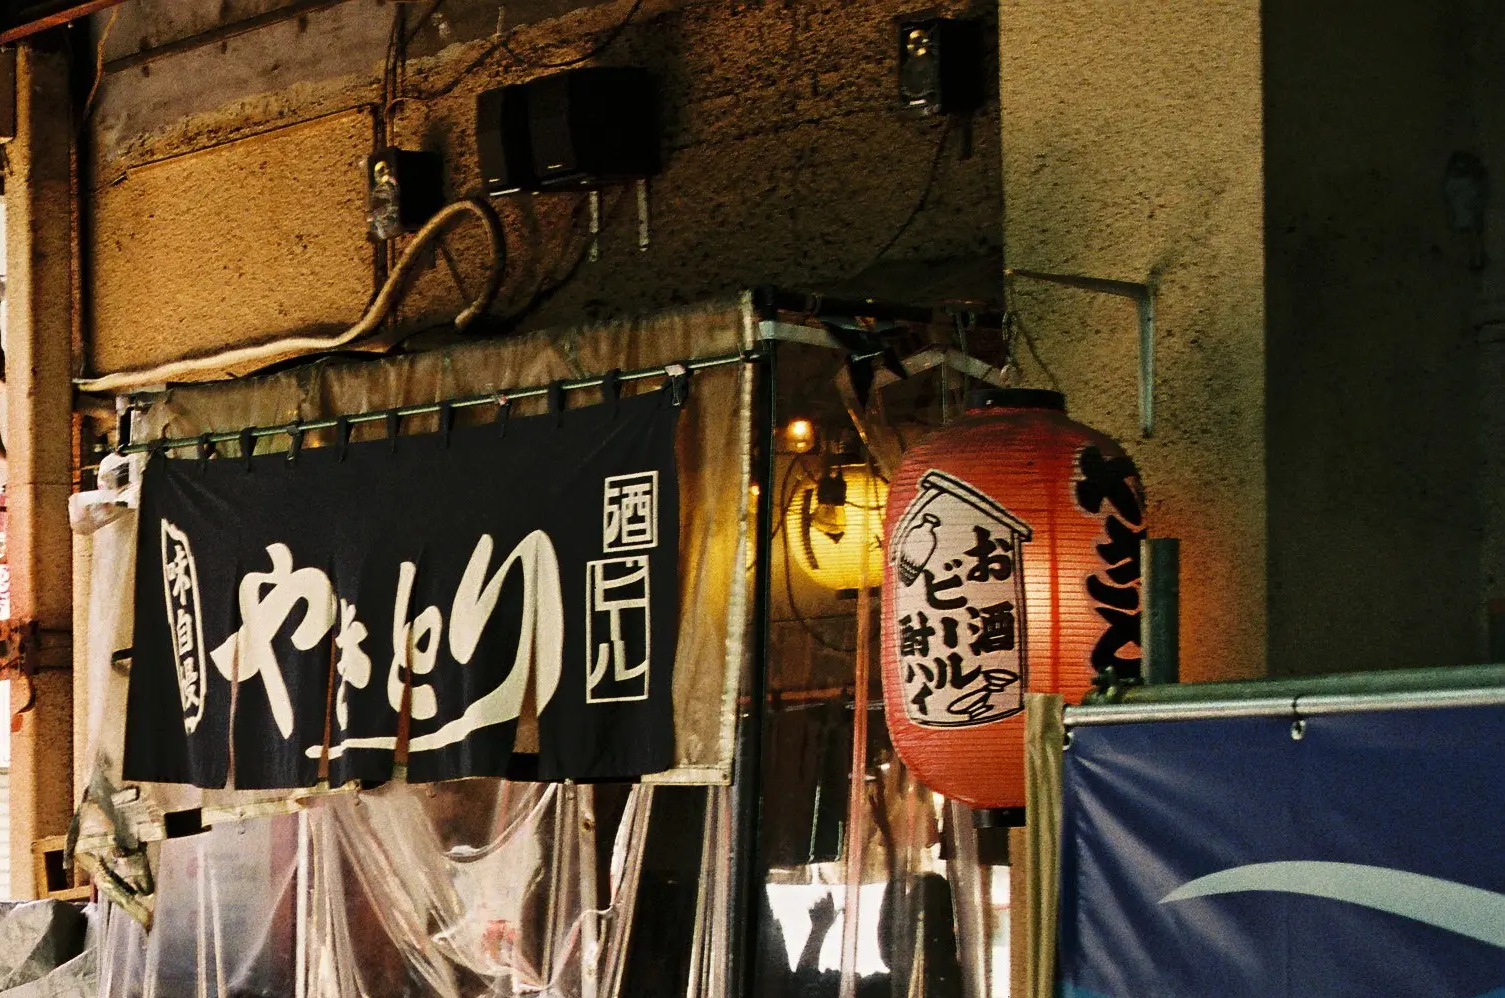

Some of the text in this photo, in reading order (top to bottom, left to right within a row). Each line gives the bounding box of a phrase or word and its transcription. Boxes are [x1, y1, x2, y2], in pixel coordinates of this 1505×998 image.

[604, 480, 654, 549] 酒
[210, 529, 564, 759] やきとり
[924, 558, 982, 690] ビール
[965, 526, 1016, 656] お酒
[899, 611, 935, 716] 酎ハイ
